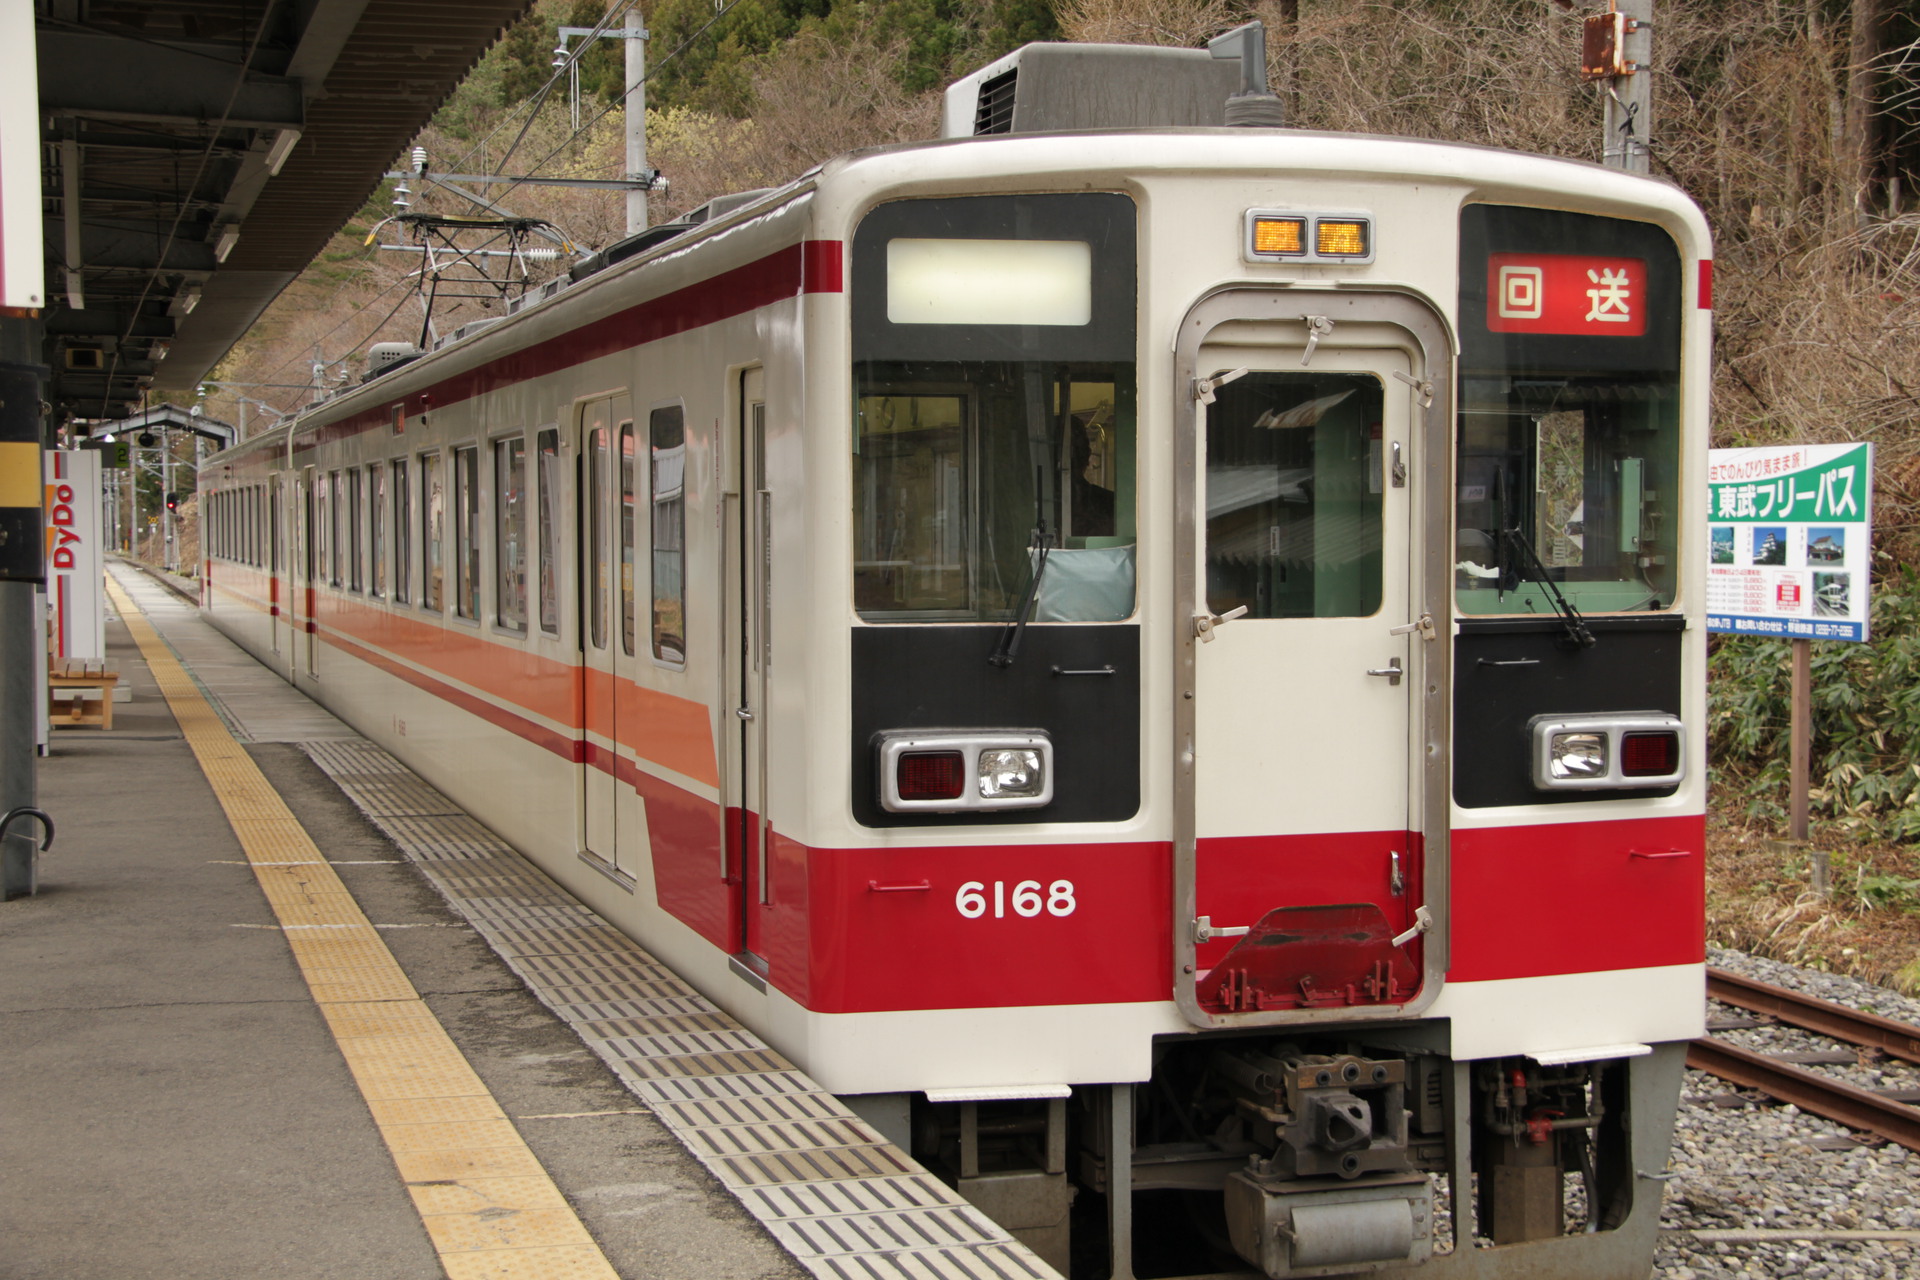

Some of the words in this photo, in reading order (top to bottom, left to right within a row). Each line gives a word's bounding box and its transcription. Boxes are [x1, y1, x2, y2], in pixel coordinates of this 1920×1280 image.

[1499, 266, 1630, 322] 回送
[118, 448, 127, 462] 2
[1718, 465, 1857, 519] 東武フリーパス
[52, 484, 80, 568] DyDo
[956, 879, 1076, 918] 6168
